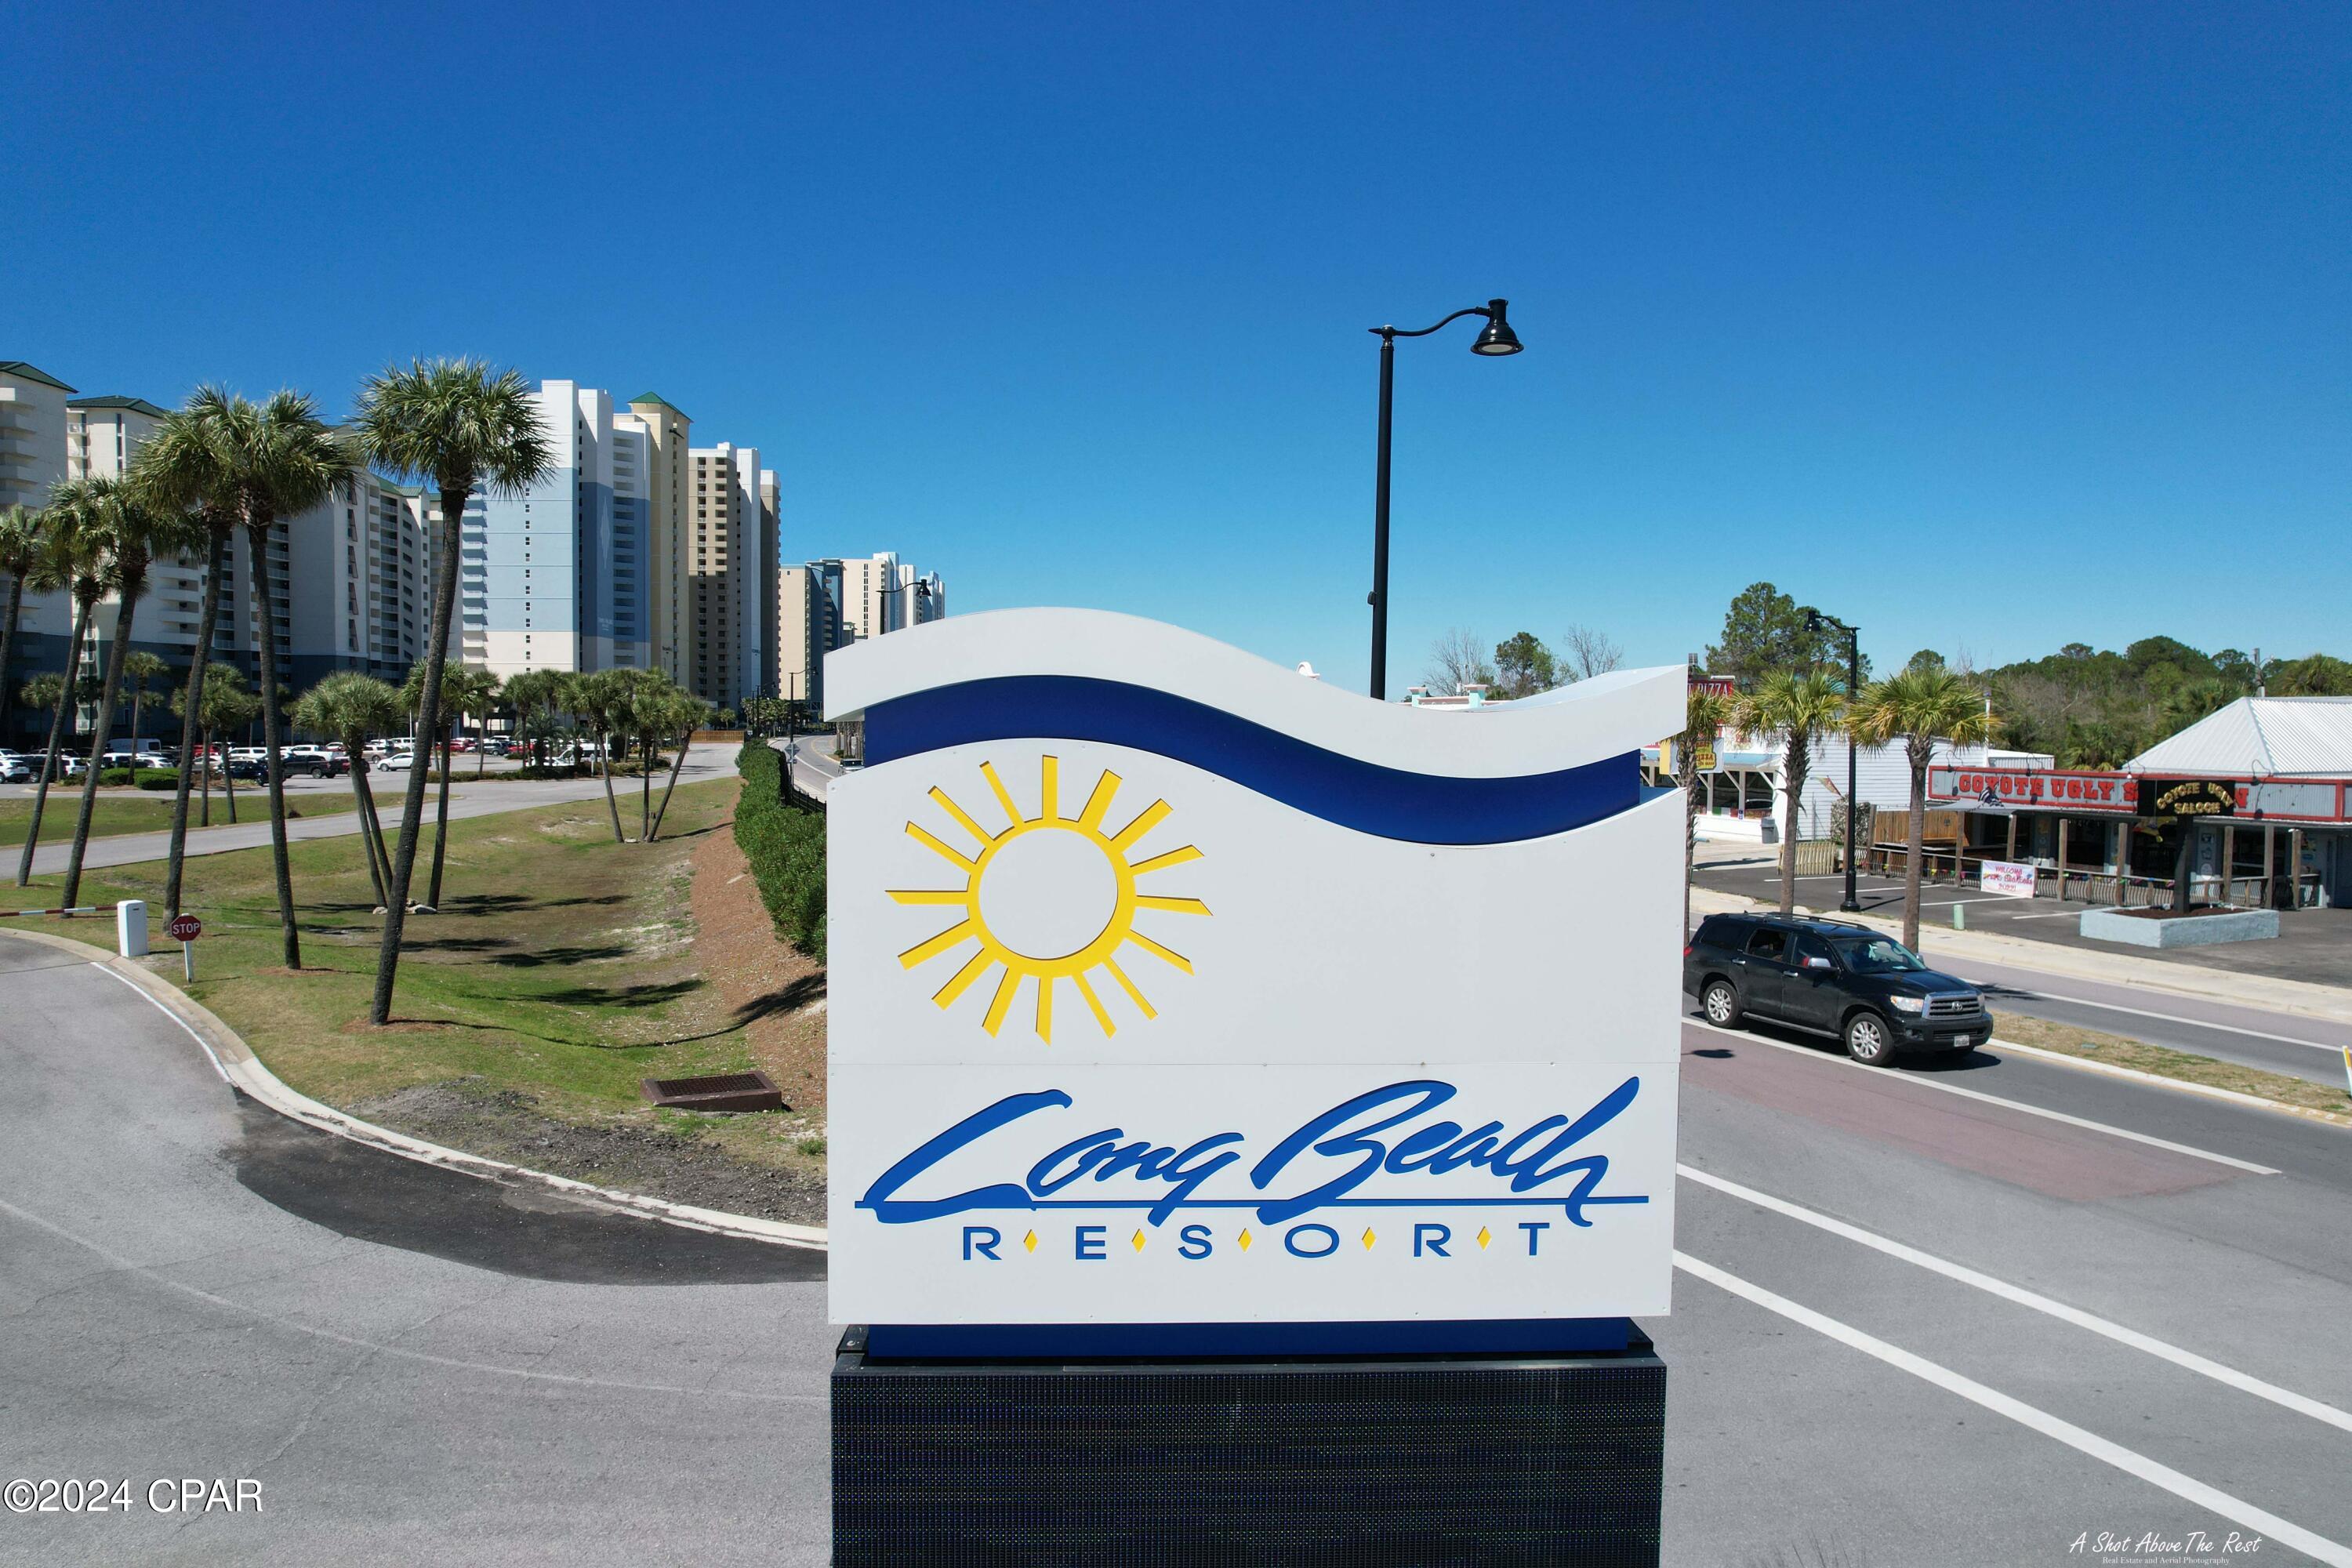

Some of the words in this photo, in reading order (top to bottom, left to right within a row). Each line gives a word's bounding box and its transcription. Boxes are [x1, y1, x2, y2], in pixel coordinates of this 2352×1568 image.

[1958, 774, 2044, 797] COYOTE
[2051, 778, 2114, 800] UGLY
[2157, 782, 2201, 810] COYOTE
[2208, 782, 2234, 808] UGLY
[2174, 801, 2221, 815] SALOON
[172, 923, 200, 935] STOP
[856, 1088, 1246, 1226] Long
[1250, 1076, 1641, 1227] Beach
